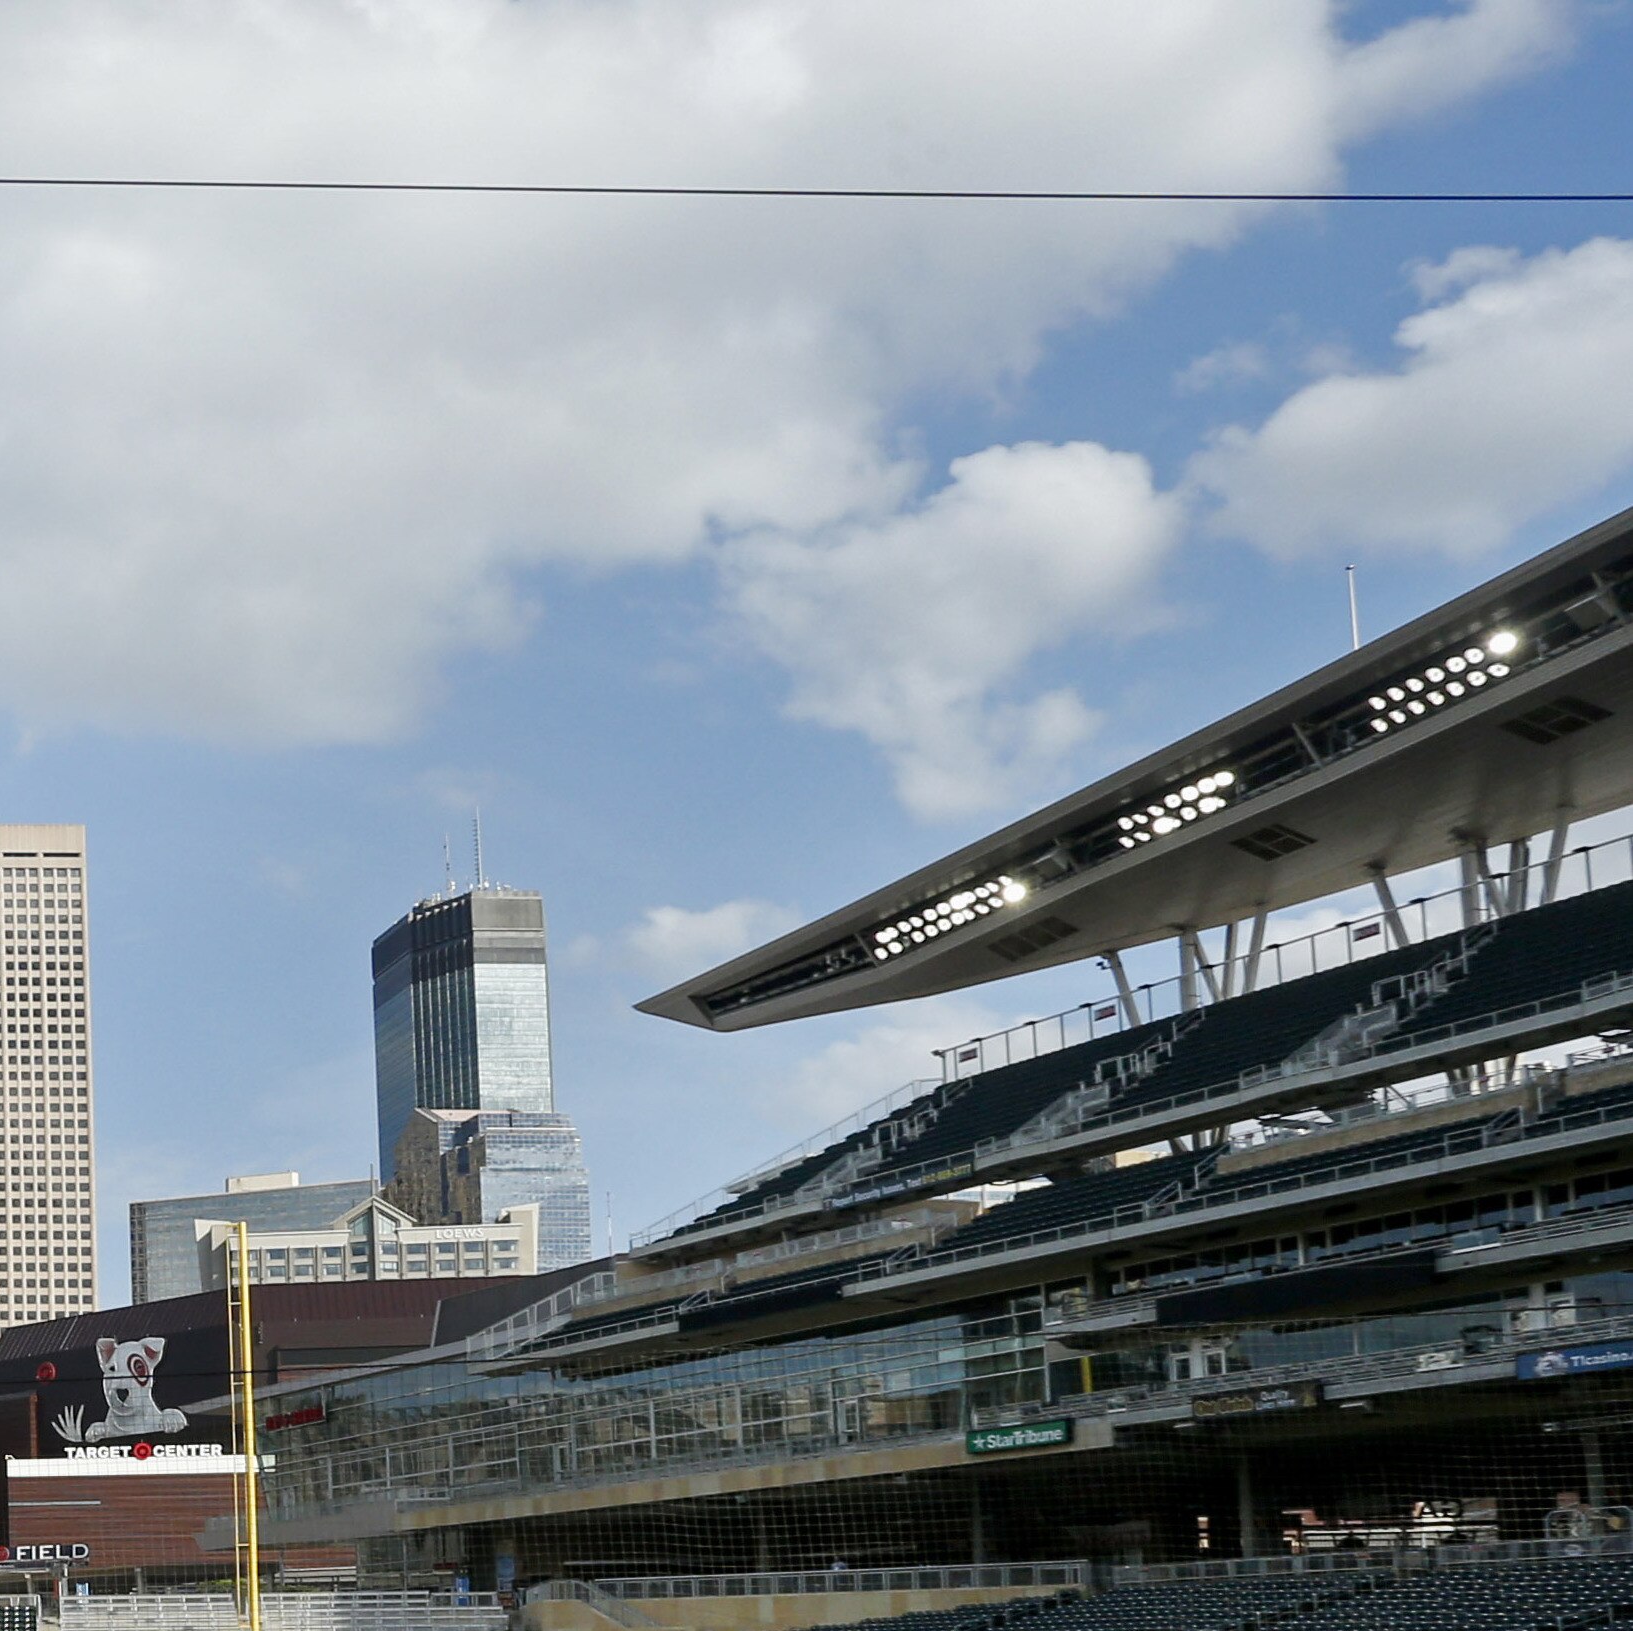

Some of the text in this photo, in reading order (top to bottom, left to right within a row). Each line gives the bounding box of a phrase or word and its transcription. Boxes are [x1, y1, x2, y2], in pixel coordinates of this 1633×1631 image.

[436, 1227, 485, 1240] LOEWS
[64, 1444, 223, 1460] TARGET CENTER
[16, 1544, 89, 1561] FIELD
